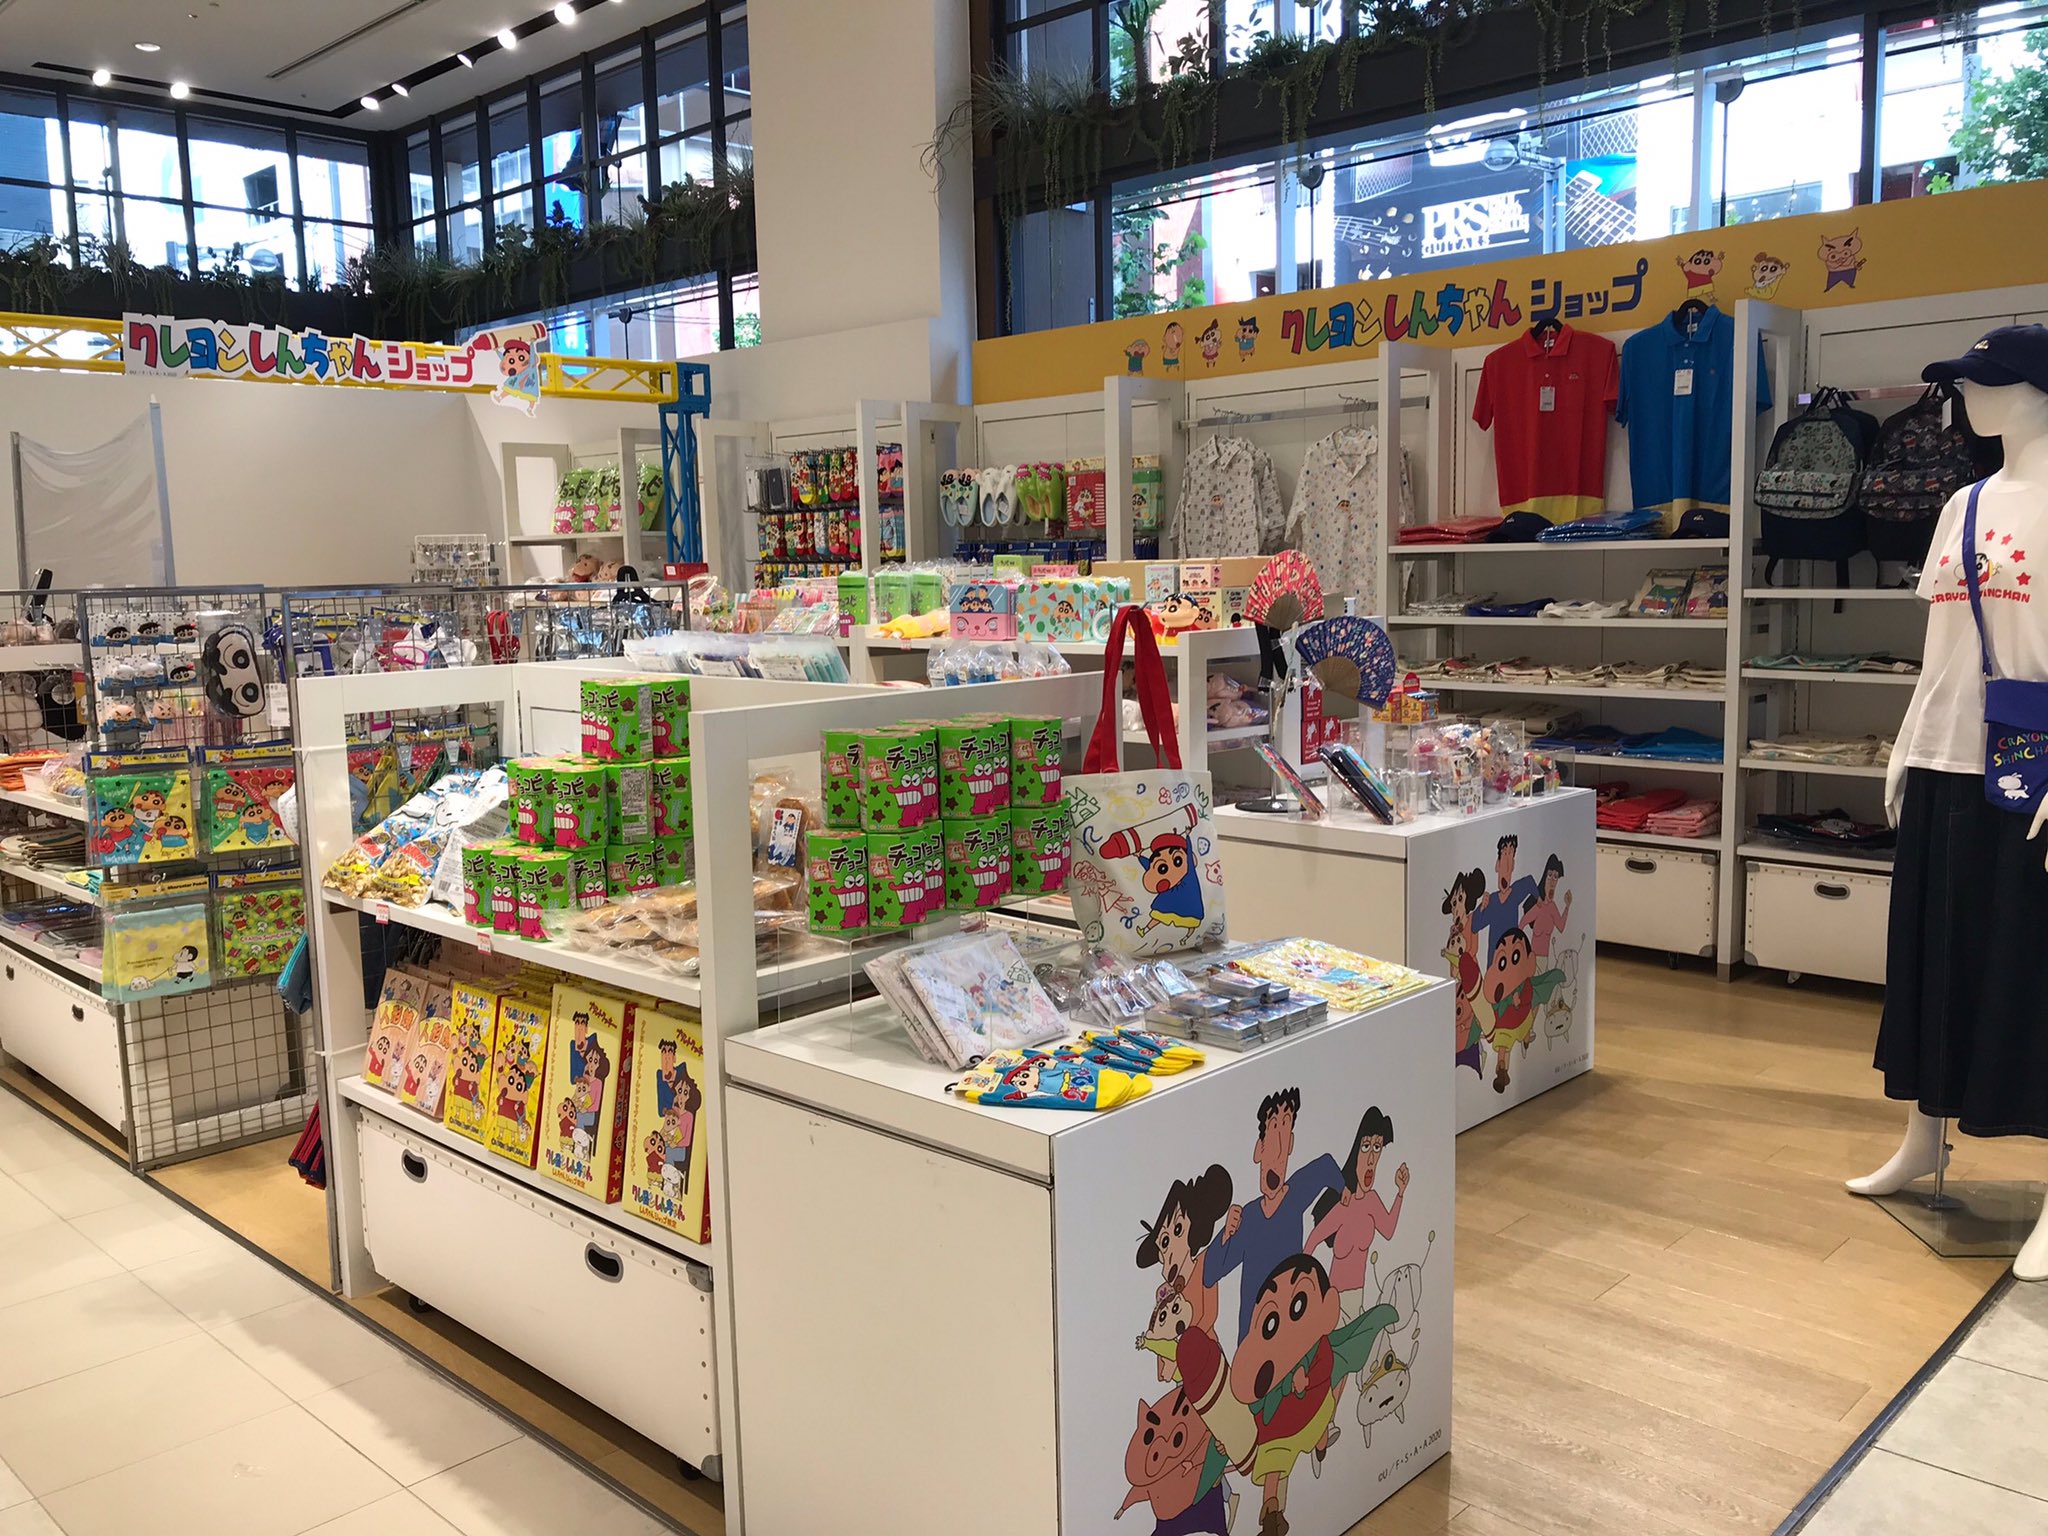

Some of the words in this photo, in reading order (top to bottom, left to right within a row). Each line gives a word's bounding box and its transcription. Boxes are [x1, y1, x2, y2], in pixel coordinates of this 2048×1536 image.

[1422, 203, 1490, 243] PRS
[1931, 592, 1971, 604] RAYO
[1979, 588, 2031, 604] INCHAN
[1998, 732, 2048, 750] CRAYON
